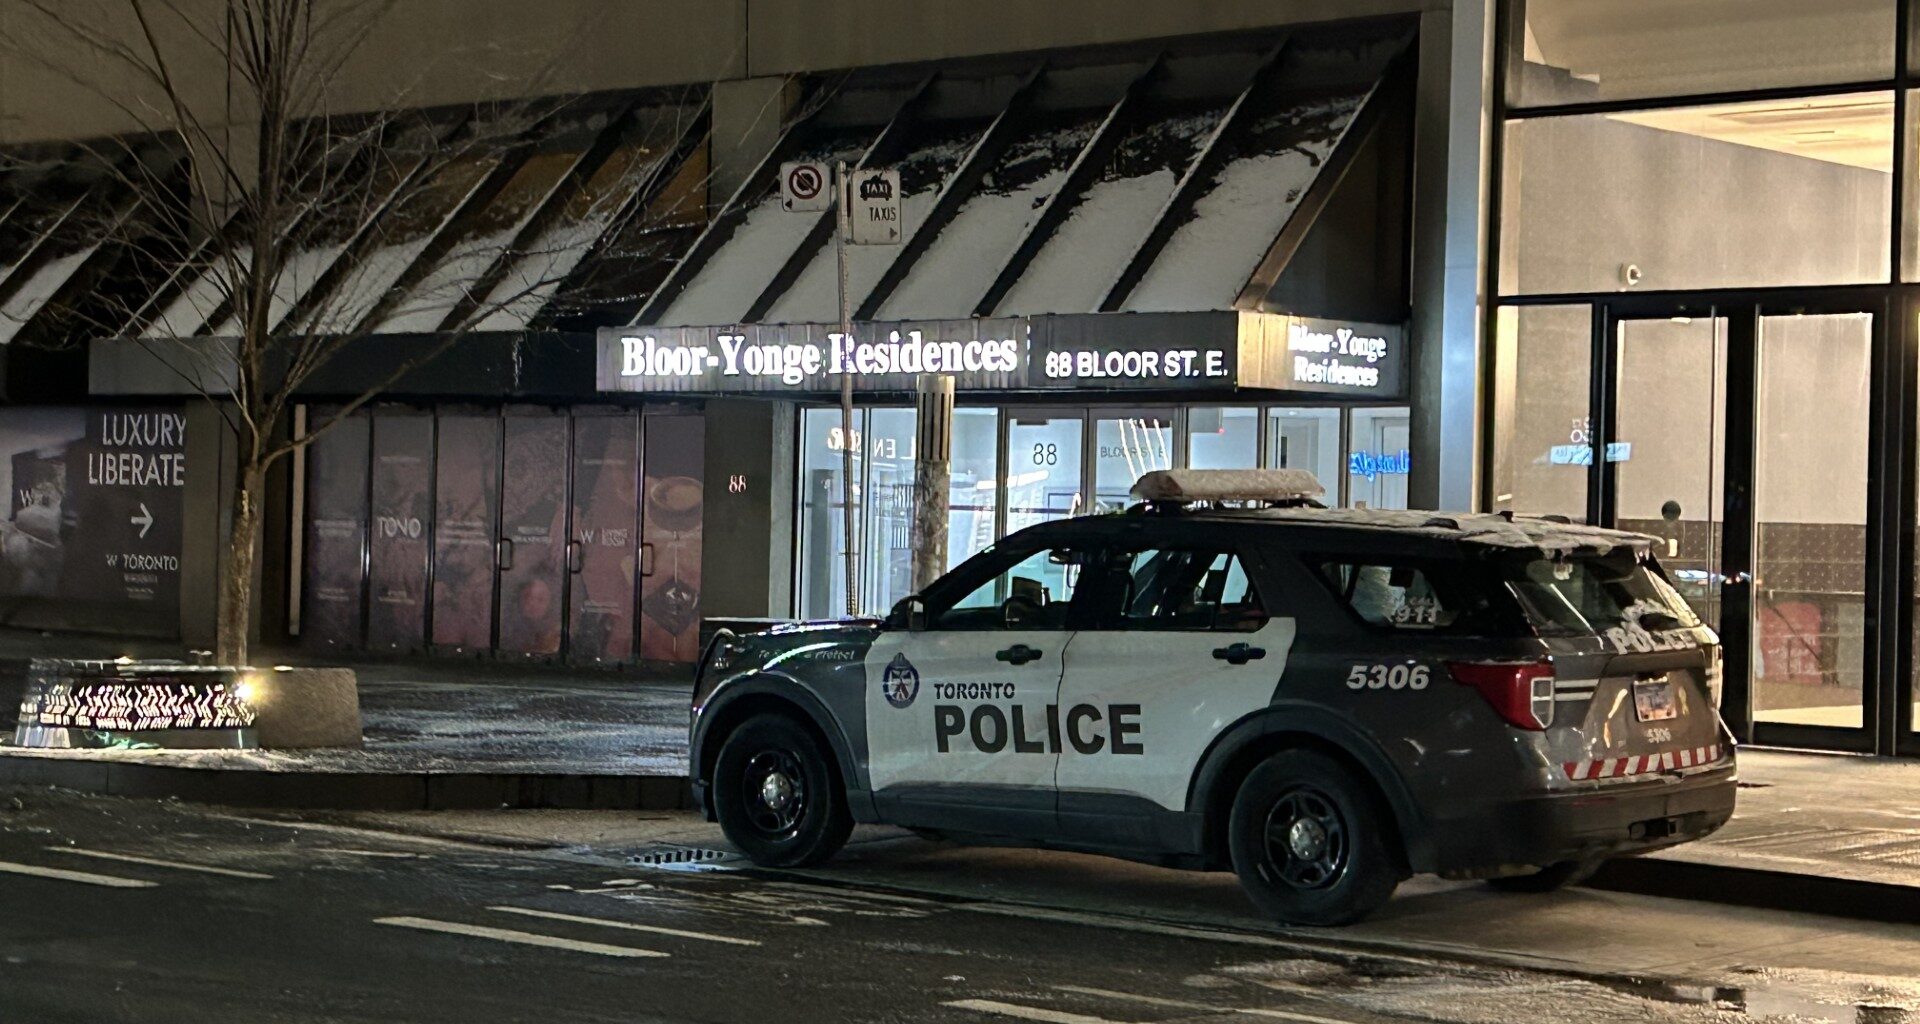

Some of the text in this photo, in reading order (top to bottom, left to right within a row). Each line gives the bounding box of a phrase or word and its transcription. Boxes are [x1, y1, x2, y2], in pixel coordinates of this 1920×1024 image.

[866, 183, 888, 193] TAXI
[868, 207, 896, 221] TAXIS
[1288, 325, 1387, 363] Bloor-Yonge
[621, 330, 1018, 385] Bloor-Yonge Residences
[1045, 350, 1228, 378] 88 BLOOR ST. E.
[1294, 355, 1379, 387] Residences
[102, 413, 187, 447] LUXURY
[1033, 443, 1057, 465] 88
[88, 453, 185, 486] LIBERATE
[728, 474, 747, 493] 88
[580, 529, 594, 544] W
[106, 554, 178, 571] W TORONTO
[1606, 626, 1697, 655] POLICE
[1347, 665, 1429, 690] 5306
[934, 683, 1016, 699] TORONTO
[934, 704, 1144, 755] POLICE
